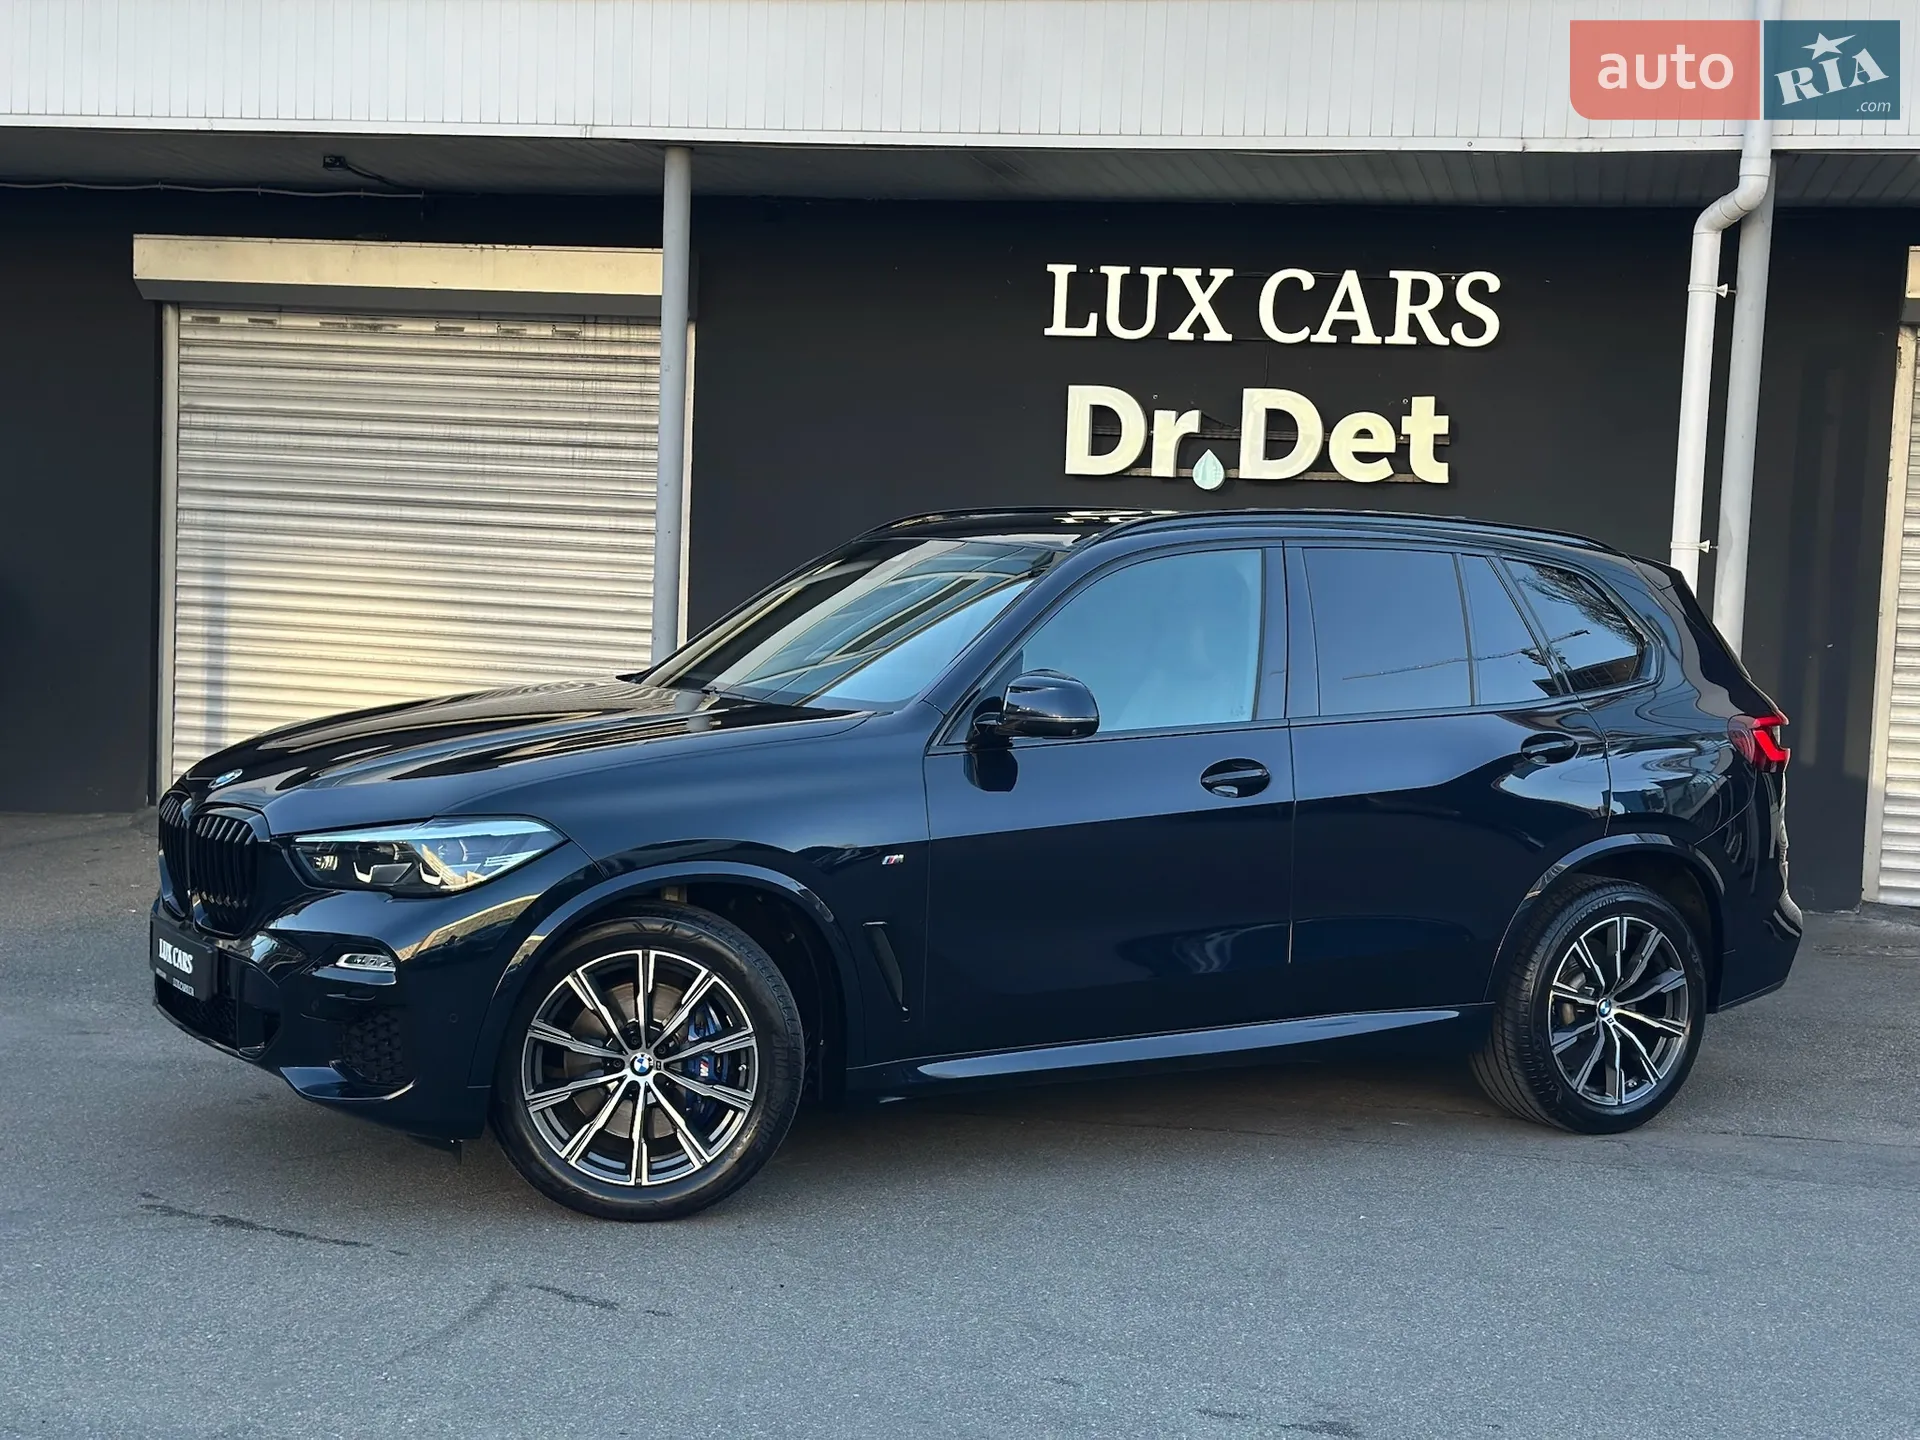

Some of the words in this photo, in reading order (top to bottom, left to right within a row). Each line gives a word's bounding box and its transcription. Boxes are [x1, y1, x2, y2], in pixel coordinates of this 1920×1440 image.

[1043, 263, 1235, 342] LUX
[1258, 268, 1501, 347] CARS
[158, 937, 173, 965] LUX
[172, 947, 193, 974] CARS
